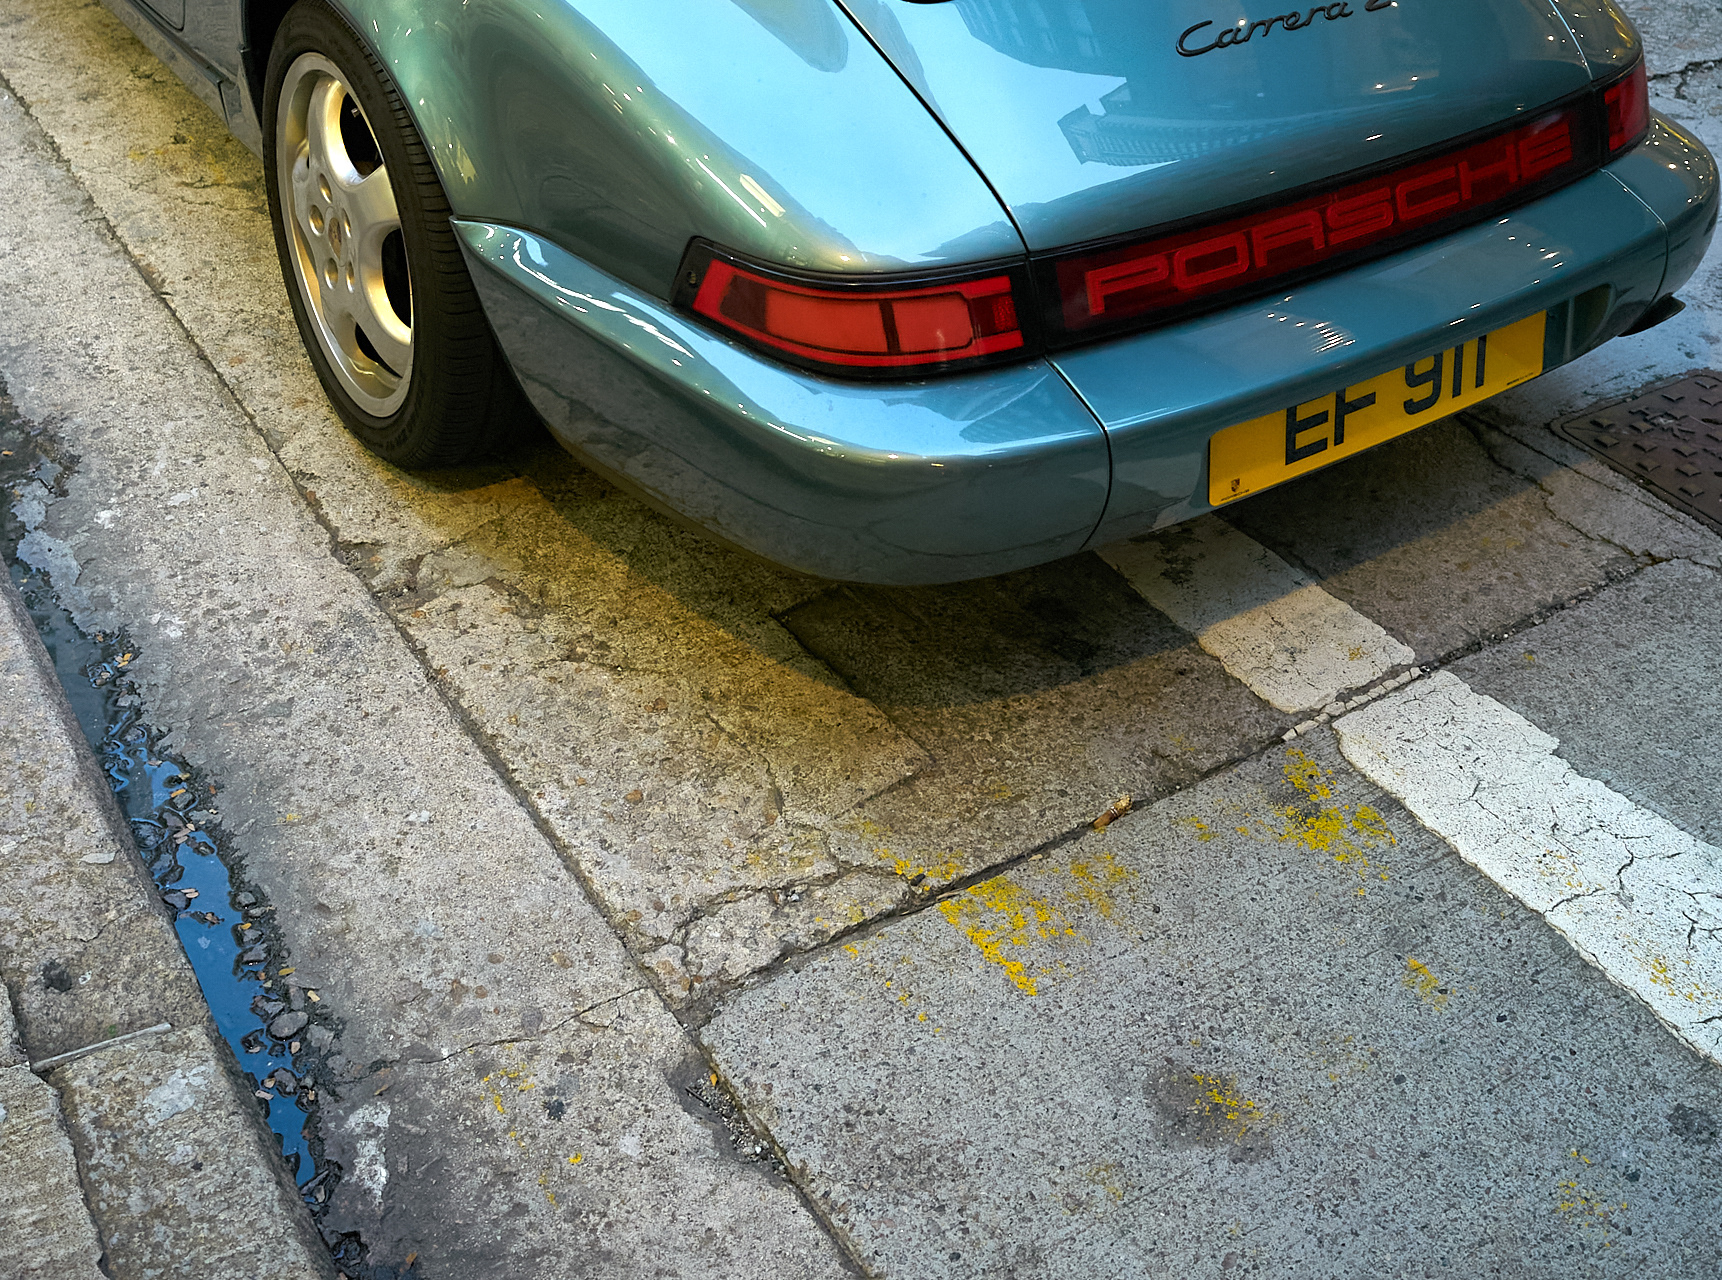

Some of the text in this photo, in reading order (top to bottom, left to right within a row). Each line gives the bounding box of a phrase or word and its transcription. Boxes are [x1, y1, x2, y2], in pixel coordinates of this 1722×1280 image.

[1175, 1, 1354, 57] Carrera
[1083, 120, 1574, 315] PORSCHE
[1402, 333, 1488, 415] 911
